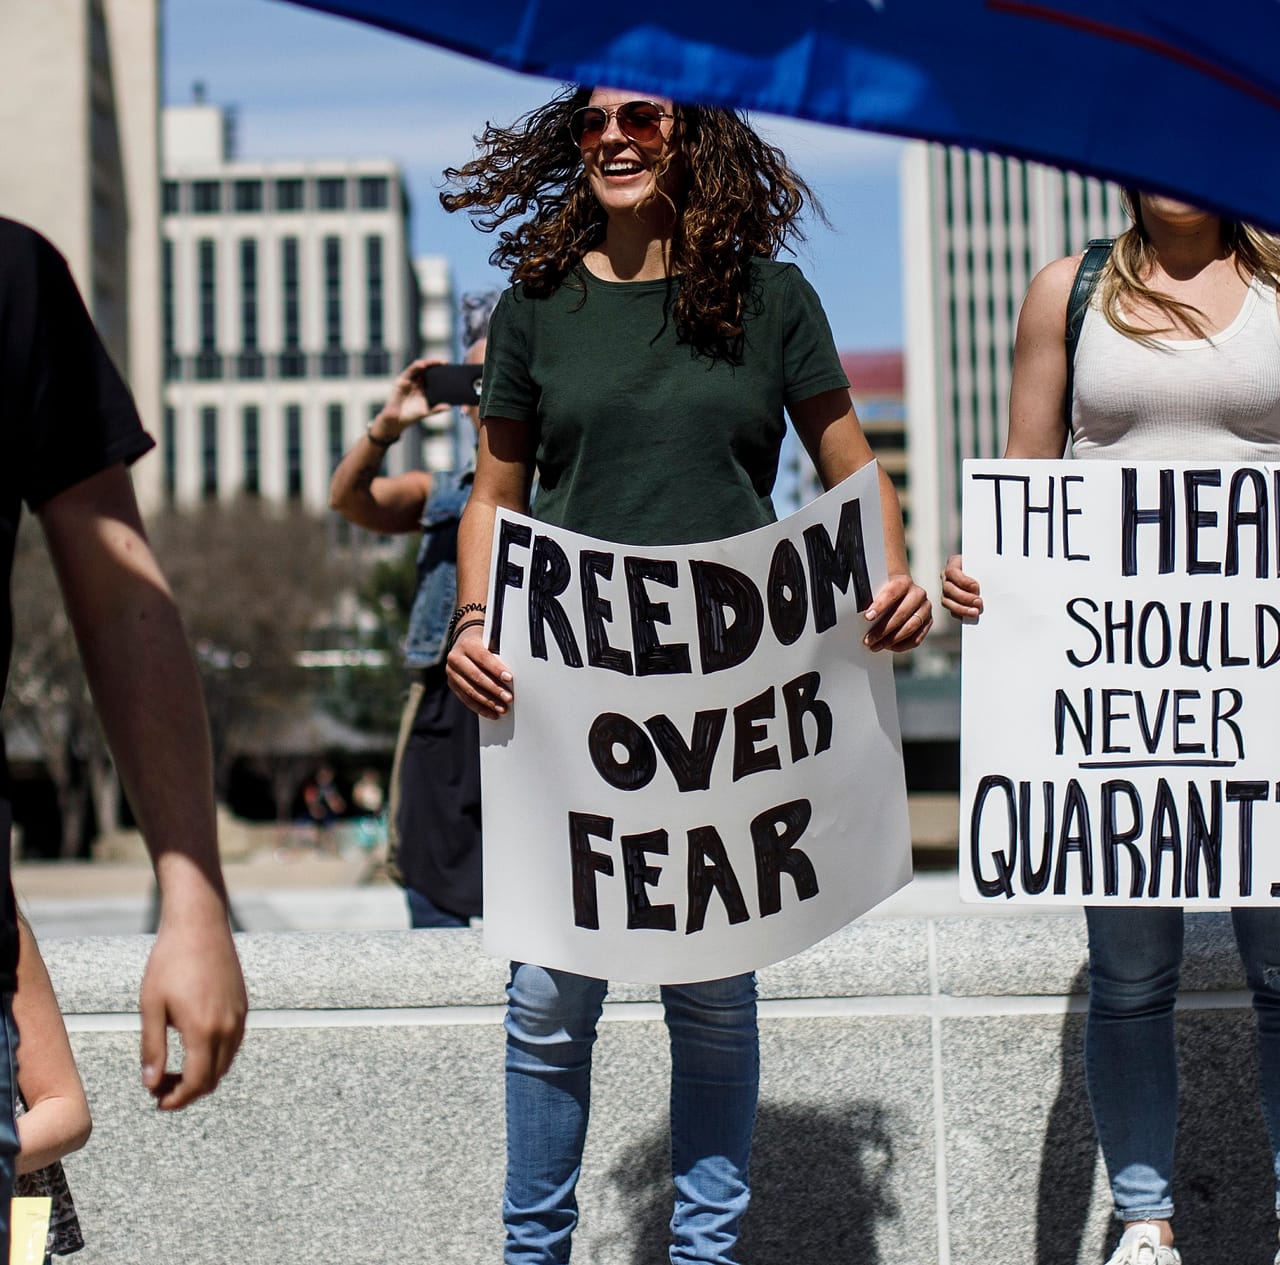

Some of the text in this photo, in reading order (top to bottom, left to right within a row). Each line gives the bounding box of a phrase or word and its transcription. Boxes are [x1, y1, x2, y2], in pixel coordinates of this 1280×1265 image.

[971, 473, 1091, 561] THE
[488, 498, 875, 676] FREEDOM
[588, 670, 833, 793] OVER
[1055, 687, 1245, 760] NEVER
[568, 798, 820, 935] FEAR
